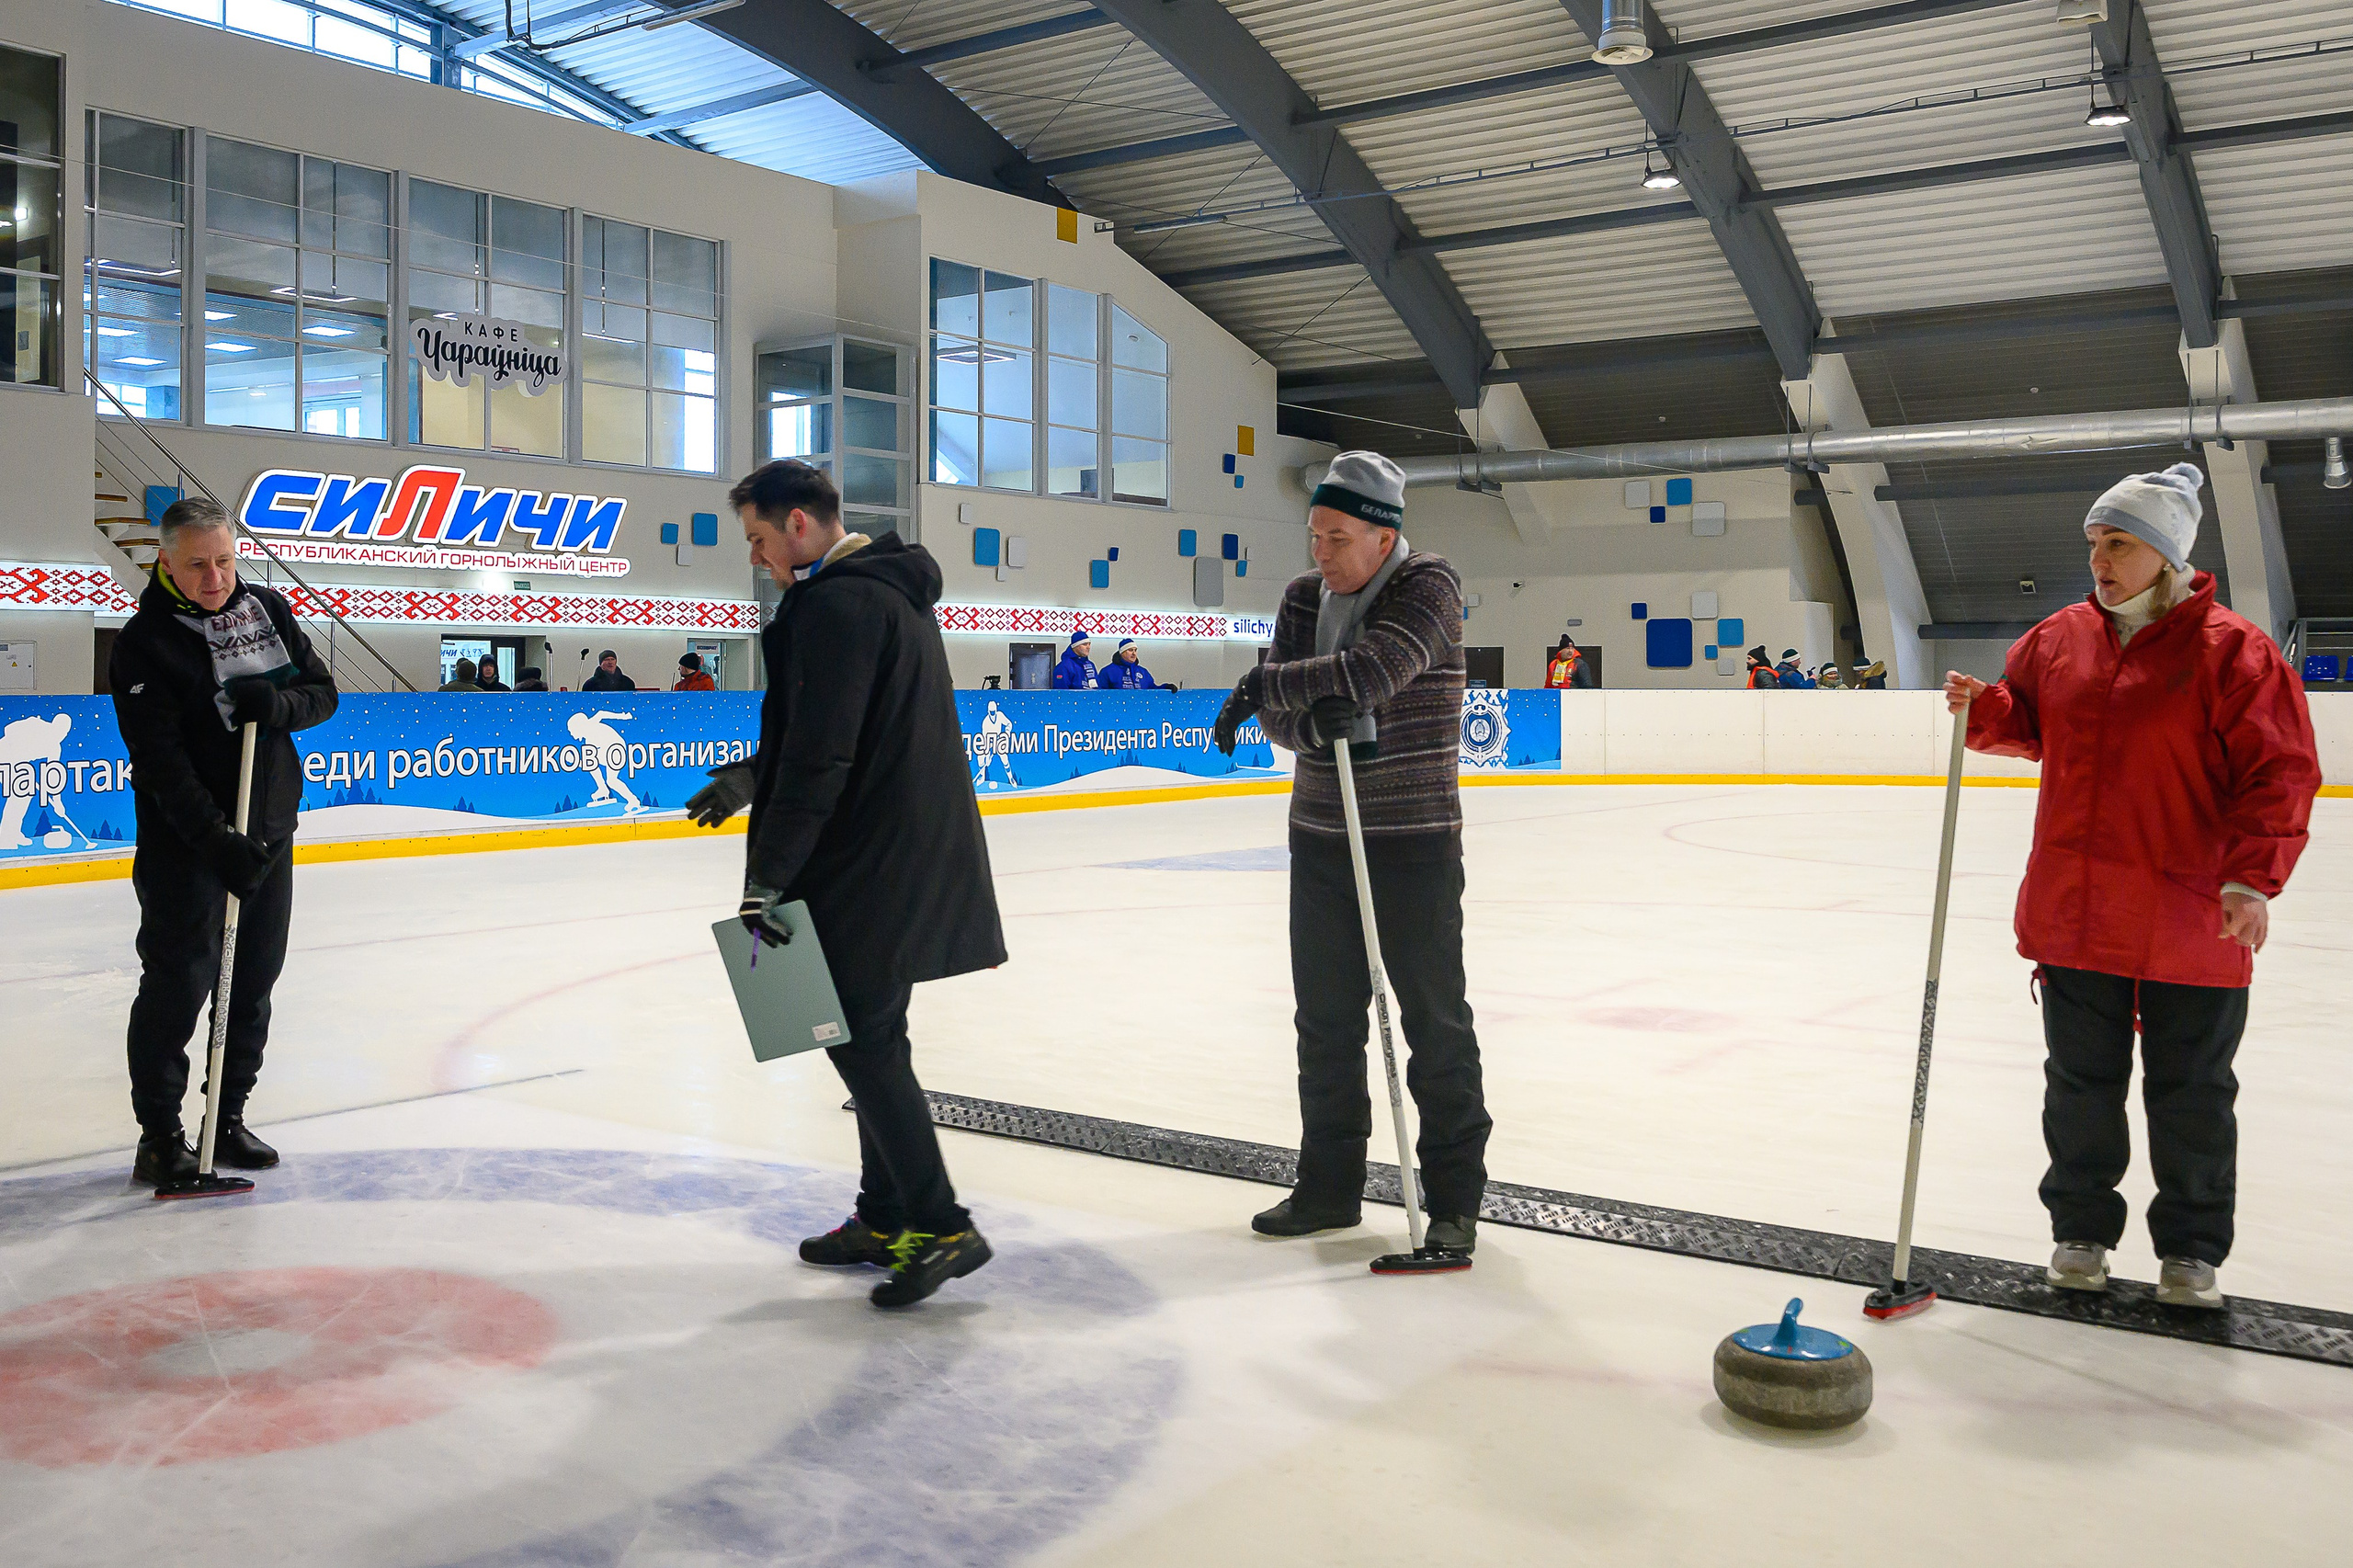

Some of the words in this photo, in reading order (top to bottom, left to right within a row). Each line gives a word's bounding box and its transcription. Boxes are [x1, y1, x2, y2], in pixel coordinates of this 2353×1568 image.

[464, 322, 518, 342] КАФЕ
[417, 327, 562, 388] Чараўніца
[240, 541, 437, 564] РЕСПУБЛИКАНСКИЙ
[440, 552, 575, 572] ГОРНОЛЫЖНЫЙ
[579, 559, 628, 574] ЦЕНТР
[1233, 619, 1274, 638] silichy
[299, 750, 376, 790] еди
[387, 736, 598, 790] работников
[961, 732, 1039, 761] делами
[1043, 723, 1157, 760] Президента
[1161, 722, 1267, 755] Респуики
